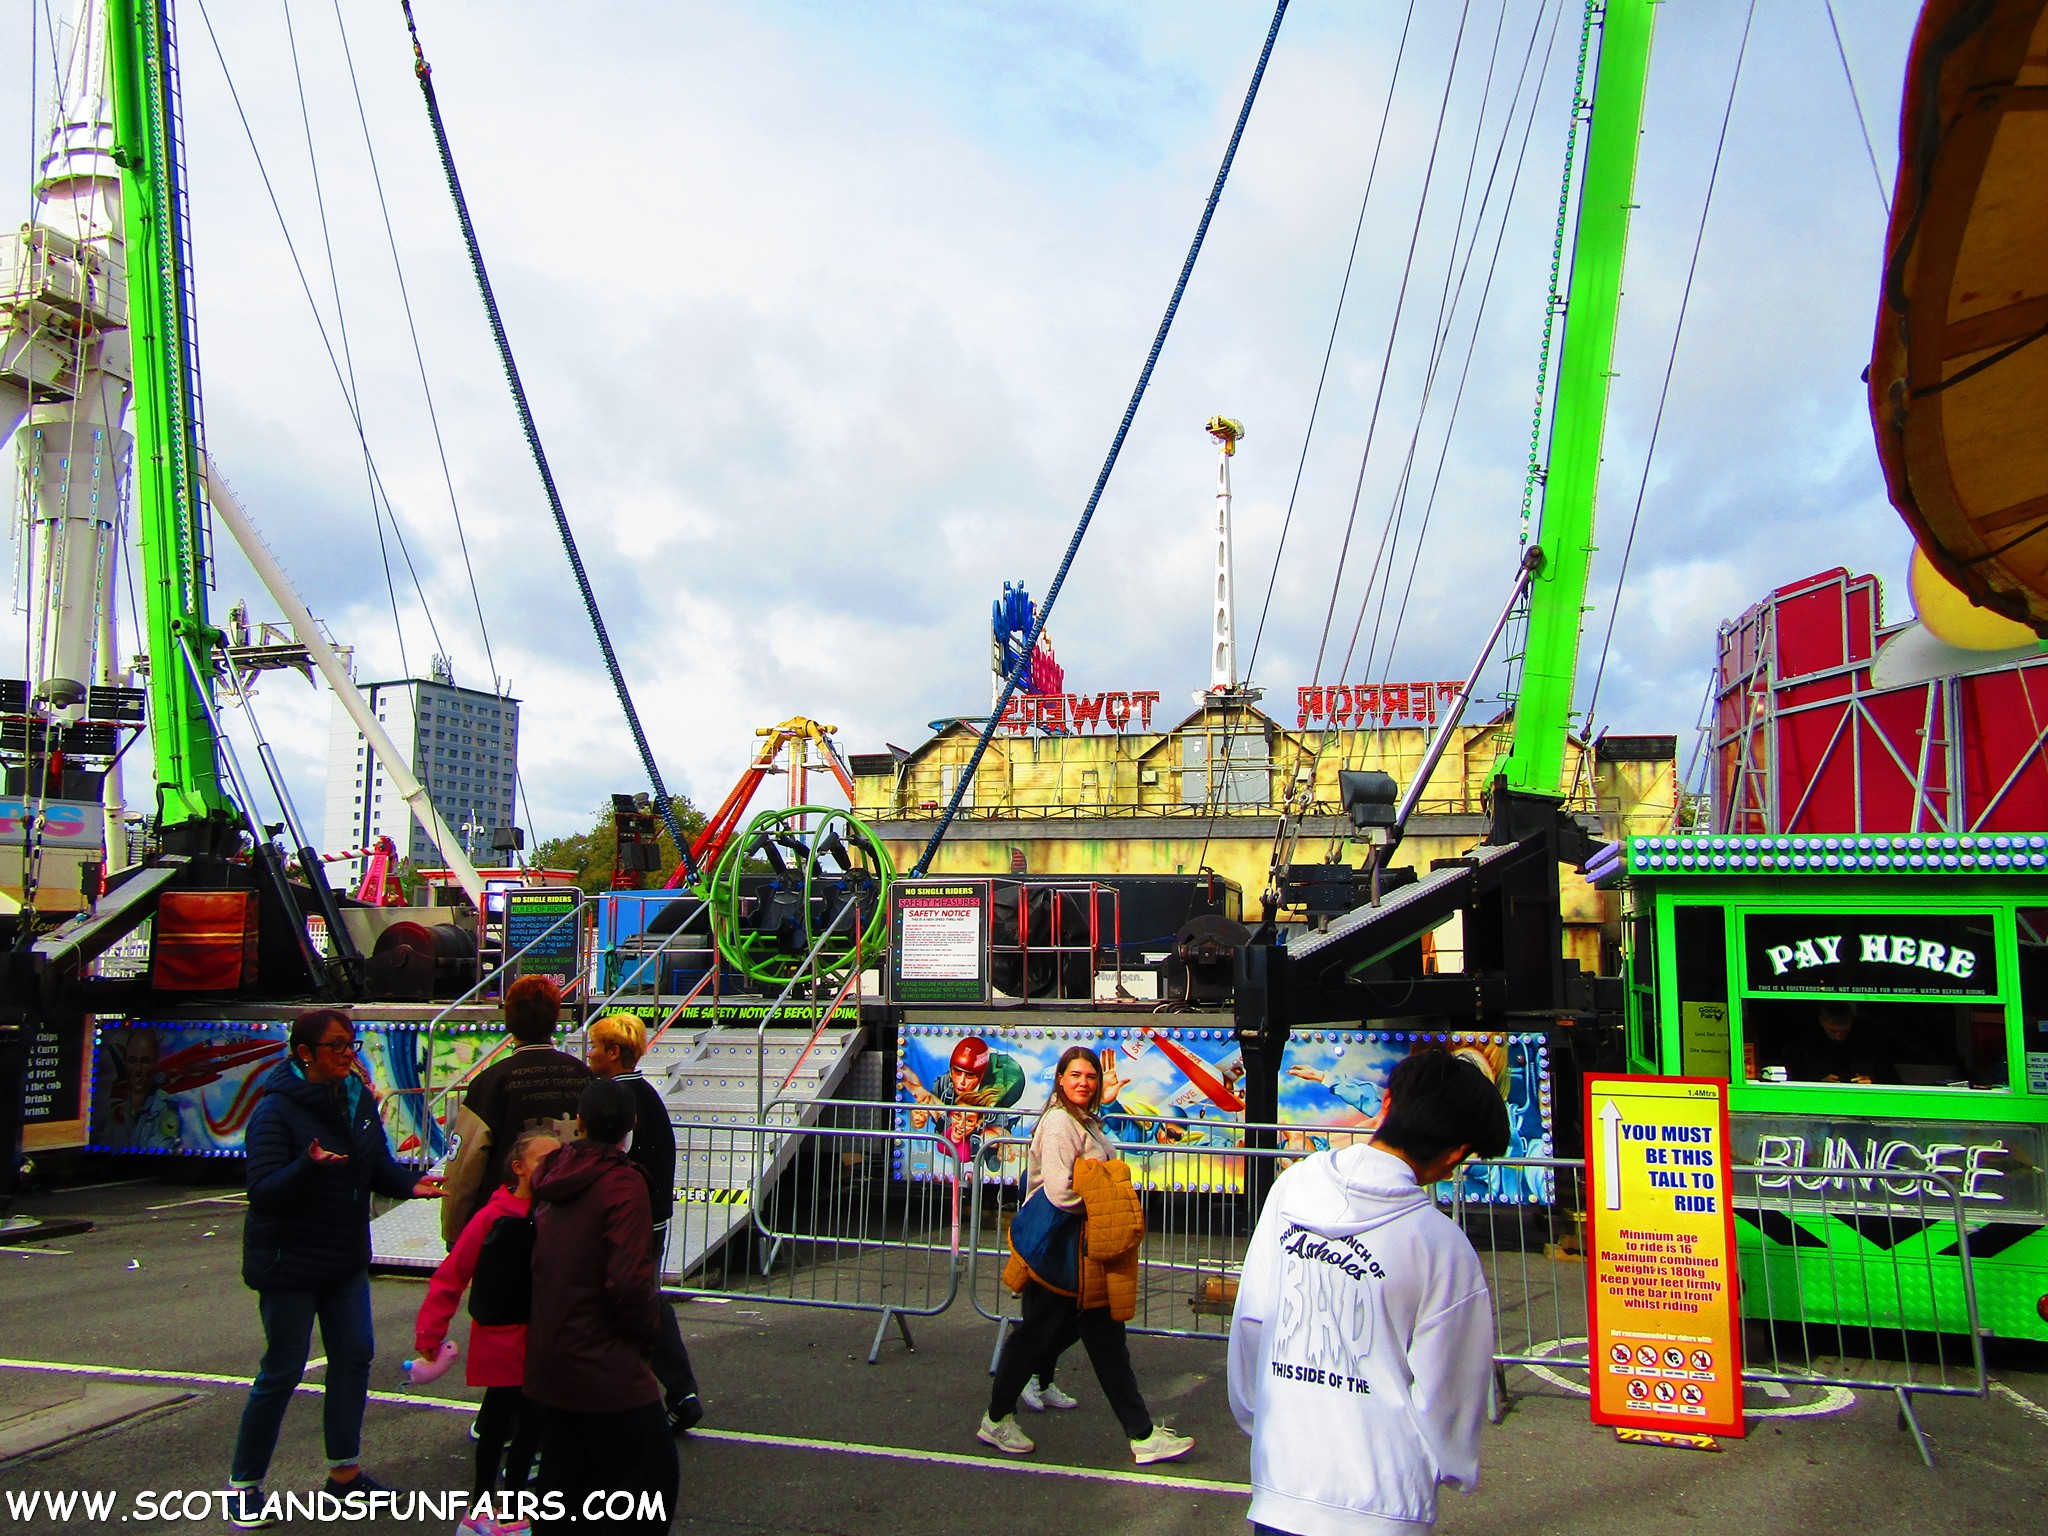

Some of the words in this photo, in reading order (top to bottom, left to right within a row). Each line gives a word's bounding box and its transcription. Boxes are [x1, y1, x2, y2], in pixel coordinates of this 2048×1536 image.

[945, 887, 973, 895] RIDERS
[512, 905, 534, 913] RULES
[536, 905, 545, 913] OF
[547, 905, 573, 913] RIDING
[900, 899, 932, 907] SAFETY
[934, 898, 978, 907] MEASURES
[1766, 935, 1842, 975] PAY
[1859, 934, 1976, 979] HERE
[682, 1007, 699, 1018] THE
[37, 1033, 58, 1042] Chips
[37, 1045, 59, 1054] Curry
[35, 1057, 59, 1067] Gravy
[548, 1065, 559, 1073] OF
[561, 1065, 576, 1073] THE
[36, 1070, 56, 1079] Fries
[31, 1082, 44, 1091] the
[46, 1081, 61, 1090] cob
[1687, 1089, 1717, 1097] 1.4Mtrs
[25, 1094, 52, 1104] Drinks
[1176, 1089, 1198, 1105] DIVE
[1621, 1124, 1656, 1141] YOU
[1661, 1126, 1712, 1143] MUST
[1645, 1147, 1667, 1164] BE
[1671, 1148, 1713, 1166] THIS
[1754, 1134, 2009, 1200] BUNGEE
[1648, 1171, 1687, 1188] TALL
[1691, 1172, 1714, 1189] TO
[1674, 1195, 1716, 1213] RIDE
[1619, 1229, 1674, 1241] Minimum
[1676, 1234, 1698, 1243] age
[1626, 1242, 1637, 1251] to
[1640, 1242, 1663, 1252] ride
[1666, 1244, 1676, 1253] is
[1679, 1244, 1692, 1254] 16
[1285, 1233, 1367, 1281] Assholes
[1601, 1251, 1657, 1263] Maximum
[1660, 1255, 1719, 1267] combined
[1369, 1261, 1386, 1279] OF
[1615, 1264, 1654, 1275] weight
[1657, 1266, 1667, 1275] is
[1671, 1267, 1705, 1279] 180kg
[1600, 1274, 1629, 1285] Keep
[1632, 1276, 1658, 1286] your
[1660, 1277, 1684, 1288] feet
[1686, 1279, 1721, 1291] firmly
[1609, 1286, 1623, 1295] on
[1626, 1287, 1645, 1297] the
[1648, 1288, 1667, 1298] bar
[1670, 1289, 1681, 1299] in
[1684, 1290, 1713, 1301] front
[1624, 1299, 1660, 1309] whilst
[1662, 1301, 1698, 1313] riding
[1610, 1329, 1622, 1337] Not
[1622, 1330, 1667, 1340] recommended
[1677, 1334, 1696, 1342] riders
[1272, 1361, 1293, 1378] THIS
[1295, 1366, 1325, 1384] SIDE
[1328, 1374, 1343, 1389] OF
[1347, 1377, 1371, 1394] THE
